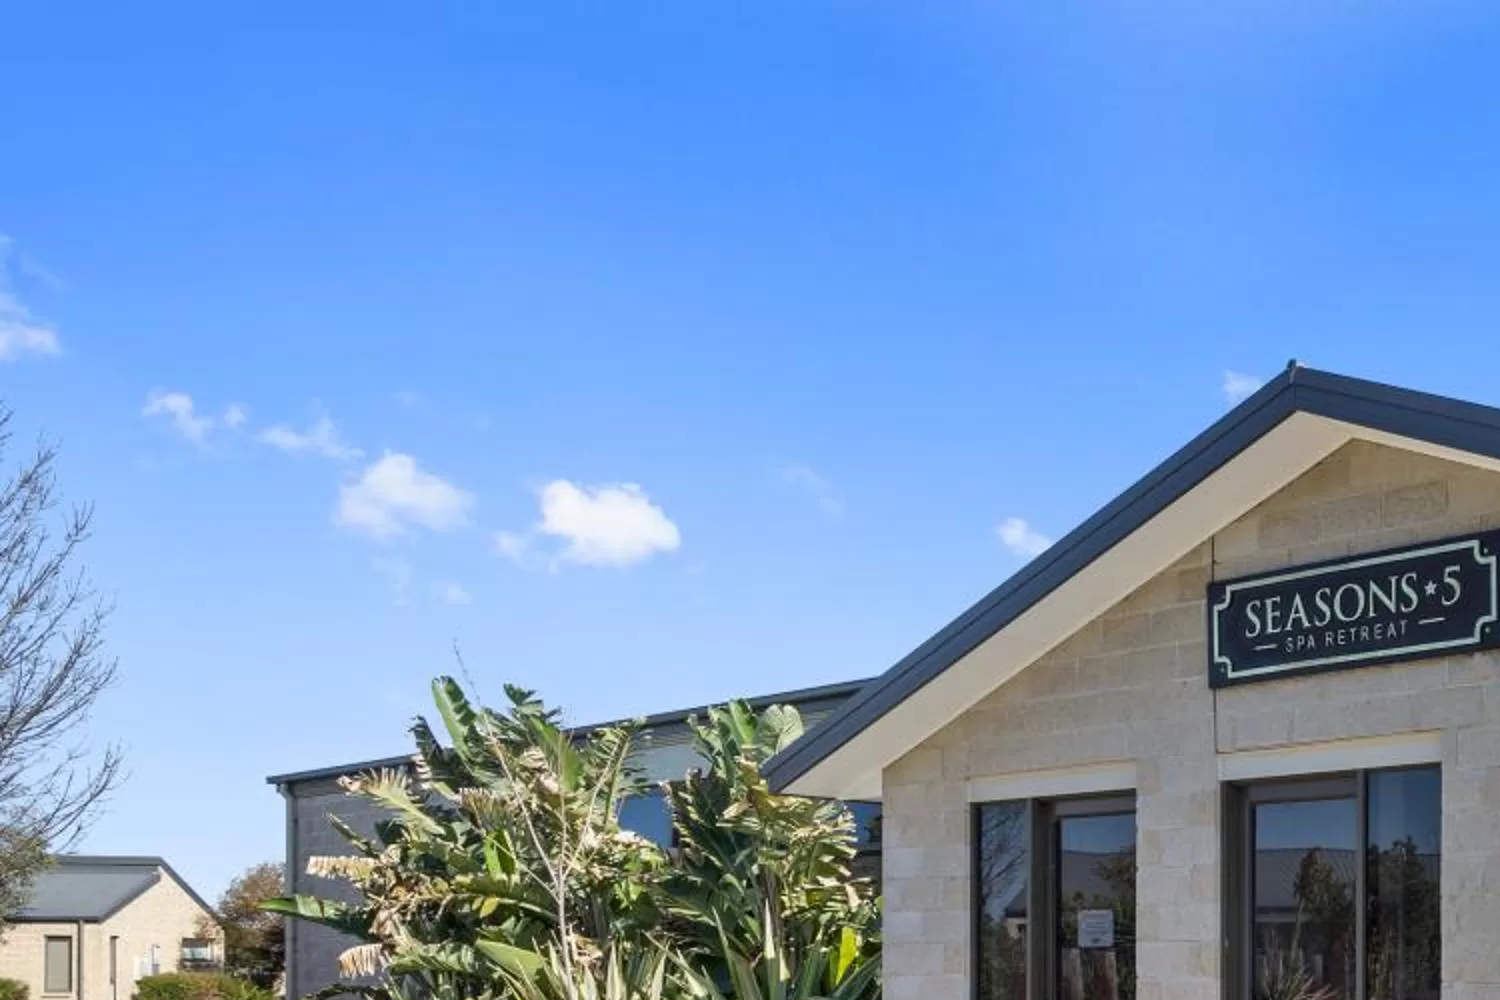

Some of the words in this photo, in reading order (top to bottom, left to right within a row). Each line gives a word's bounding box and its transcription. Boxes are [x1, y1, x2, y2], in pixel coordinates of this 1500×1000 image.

[1244, 571, 1419, 638] SEASONS
[1440, 564, 1462, 606] 5
[1284, 634, 1316, 653] SPA
[1324, 619, 1409, 646] RETREAT
